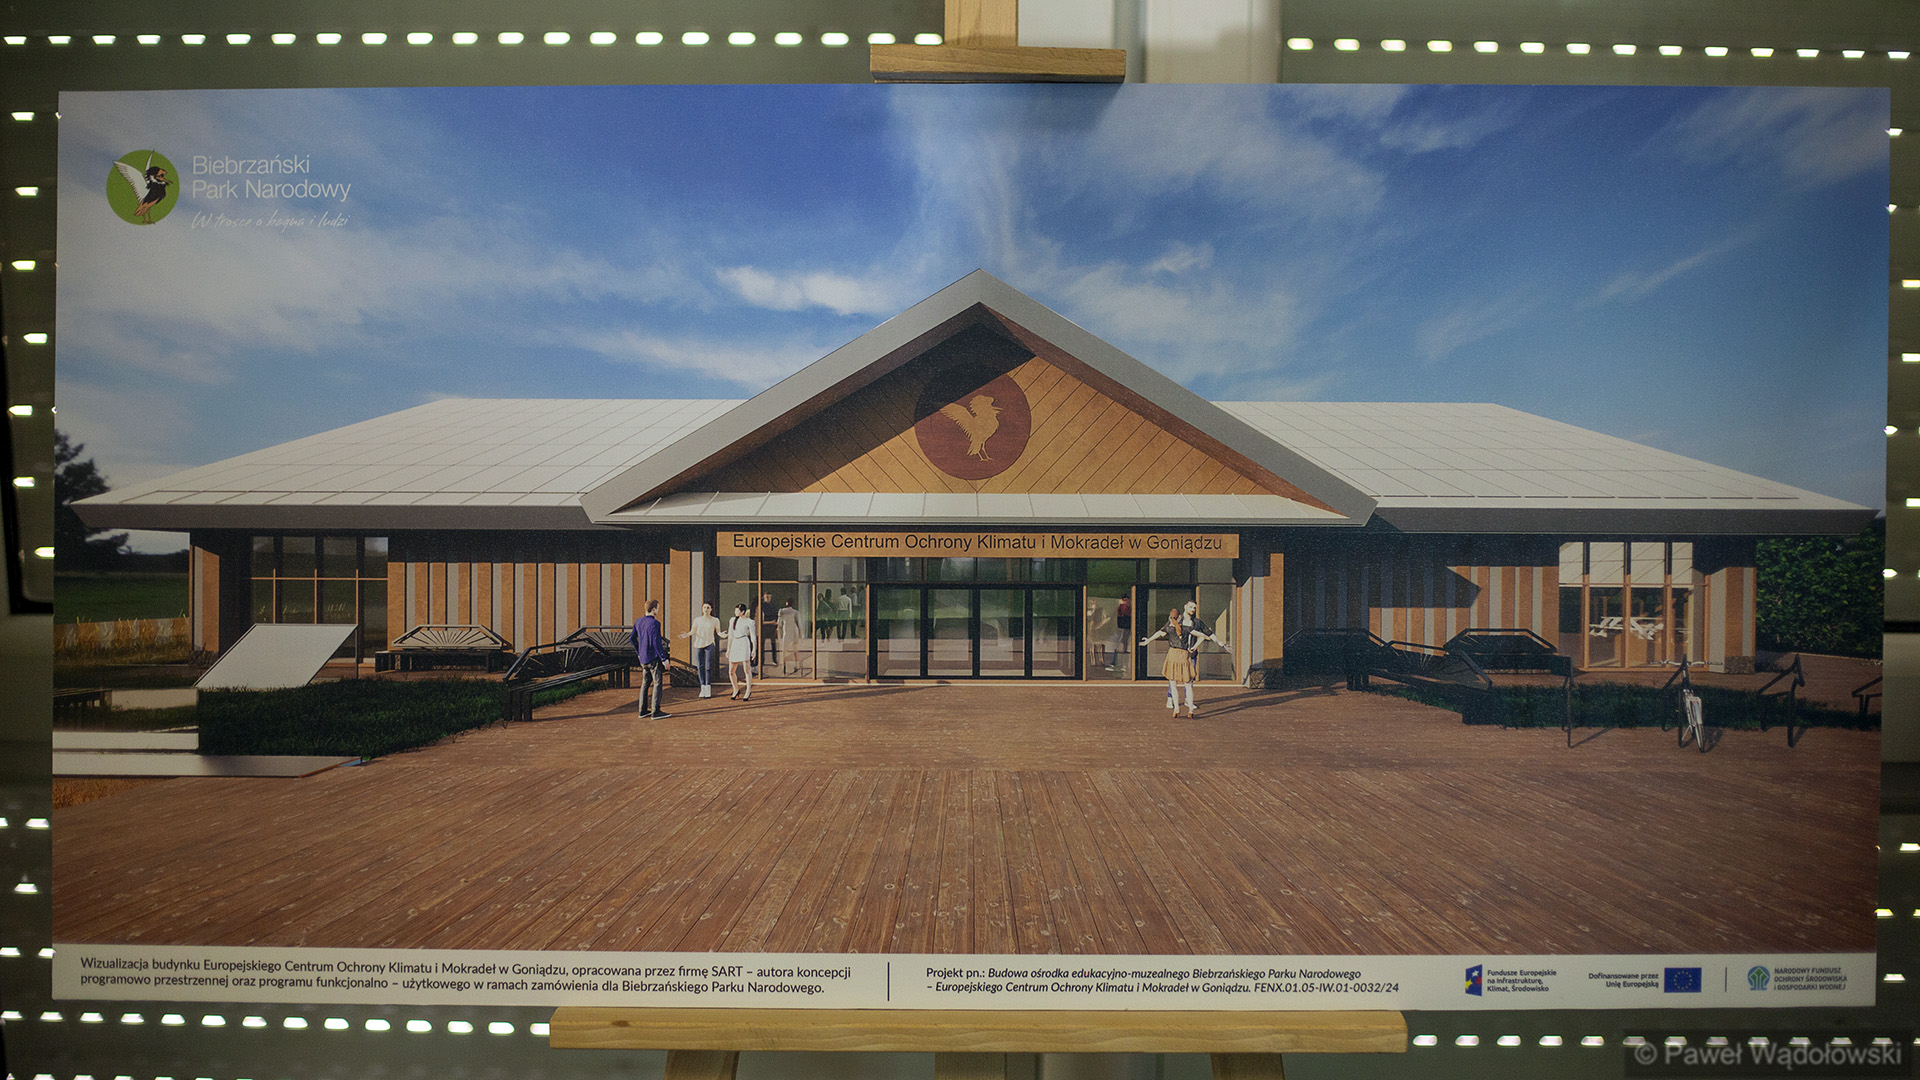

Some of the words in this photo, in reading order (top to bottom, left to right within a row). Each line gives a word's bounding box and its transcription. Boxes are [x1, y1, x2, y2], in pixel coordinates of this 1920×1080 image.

[193, 154, 310, 175] Biebrzański
[193, 180, 239, 200] Park
[245, 179, 352, 203] Narodowy
[733, 534, 826, 552] Europejskie
[831, 534, 899, 549] Centrum
[904, 535, 973, 553] Ochrony
[977, 535, 1036, 549] Klimatu
[1051, 535, 1124, 550] Mokradeł
[1128, 539, 1142, 550] w
[1146, 536, 1222, 553] Goniądzu
[80, 957, 149, 972] Wizualizacja
[152, 958, 201, 972] budynku
[203, 959, 282, 974] Europejskiego
[284, 960, 334, 973] Centrum
[336, 961, 386, 975] Ochrony
[388, 961, 432, 974] Klimatu
[441, 962, 497, 975] Mokradeł
[498, 966, 510, 975] w
[511, 963, 569, 978] Goniądzu,
[571, 966, 642, 978] opracowana
[644, 967, 676, 979] przez
[678, 965, 709, 980] firmę
[711, 965, 744, 978] SART
[756, 966, 794, 978] autora
[796, 966, 851, 980] koncepcji
[926, 967, 964, 980] Projekt
[965, 969, 986, 980] pn.:
[987, 967, 1029, 979] Budowa
[1030, 967, 1070, 979] ośrodka
[1071, 968, 1191, 981] edukacyjno-muzealnego
[1192, 968, 1266, 981] Biebrzańskiego
[1267, 968, 1297, 979] Parku
[1298, 968, 1362, 981] Narodowego
[80, 975, 151, 987] programowo
[154, 974, 229, 988] przestrzennej
[231, 977, 256, 987] oraz
[258, 978, 313, 989] programu
[315, 976, 389, 990] funkcjonalno
[402, 977, 471, 992] użytkowego
[473, 980, 485, 990] w
[486, 978, 528, 991] ramach
[531, 979, 599, 992] zamówienia
[601, 979, 619, 992] dla
[622, 979, 709, 995] Biebrzańskiego
[711, 980, 745, 993] Parku
[747, 981, 825, 996] Narodowego.
[935, 981, 1004, 994] Europejskiego
[1005, 981, 1049, 993] Centrum
[1050, 981, 1094, 994] Ochrony
[1095, 981, 1135, 993] Klimatu
[1141, 981, 1190, 993] Mokradeł
[1190, 983, 1202, 993] w
[1201, 981, 1252, 995] Goniądzu.
[1253, 981, 1400, 994] FENX.01.05-IW.01-0032/24
[1805, 975, 1848, 983] ŚRODOWISKA
